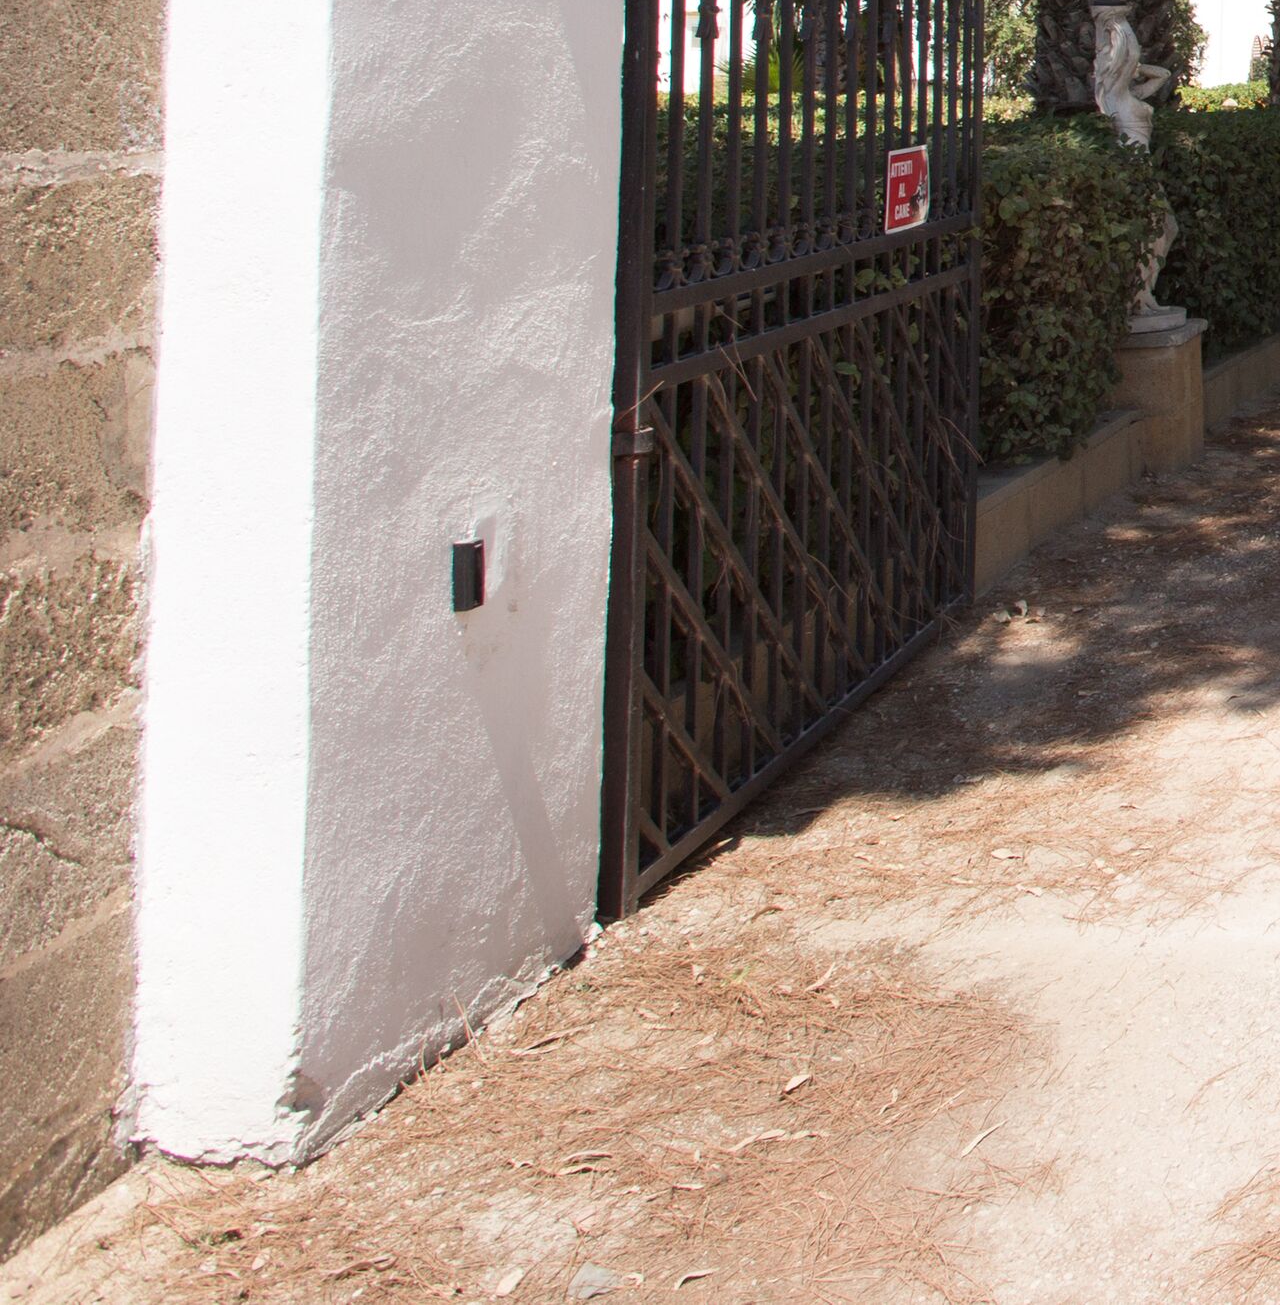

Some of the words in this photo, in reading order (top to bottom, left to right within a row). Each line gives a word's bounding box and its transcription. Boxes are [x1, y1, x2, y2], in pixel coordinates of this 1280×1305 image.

[890, 160, 912, 178] ATTENTI
[898, 182, 906, 198] AL
[894, 202, 910, 220] CANE
